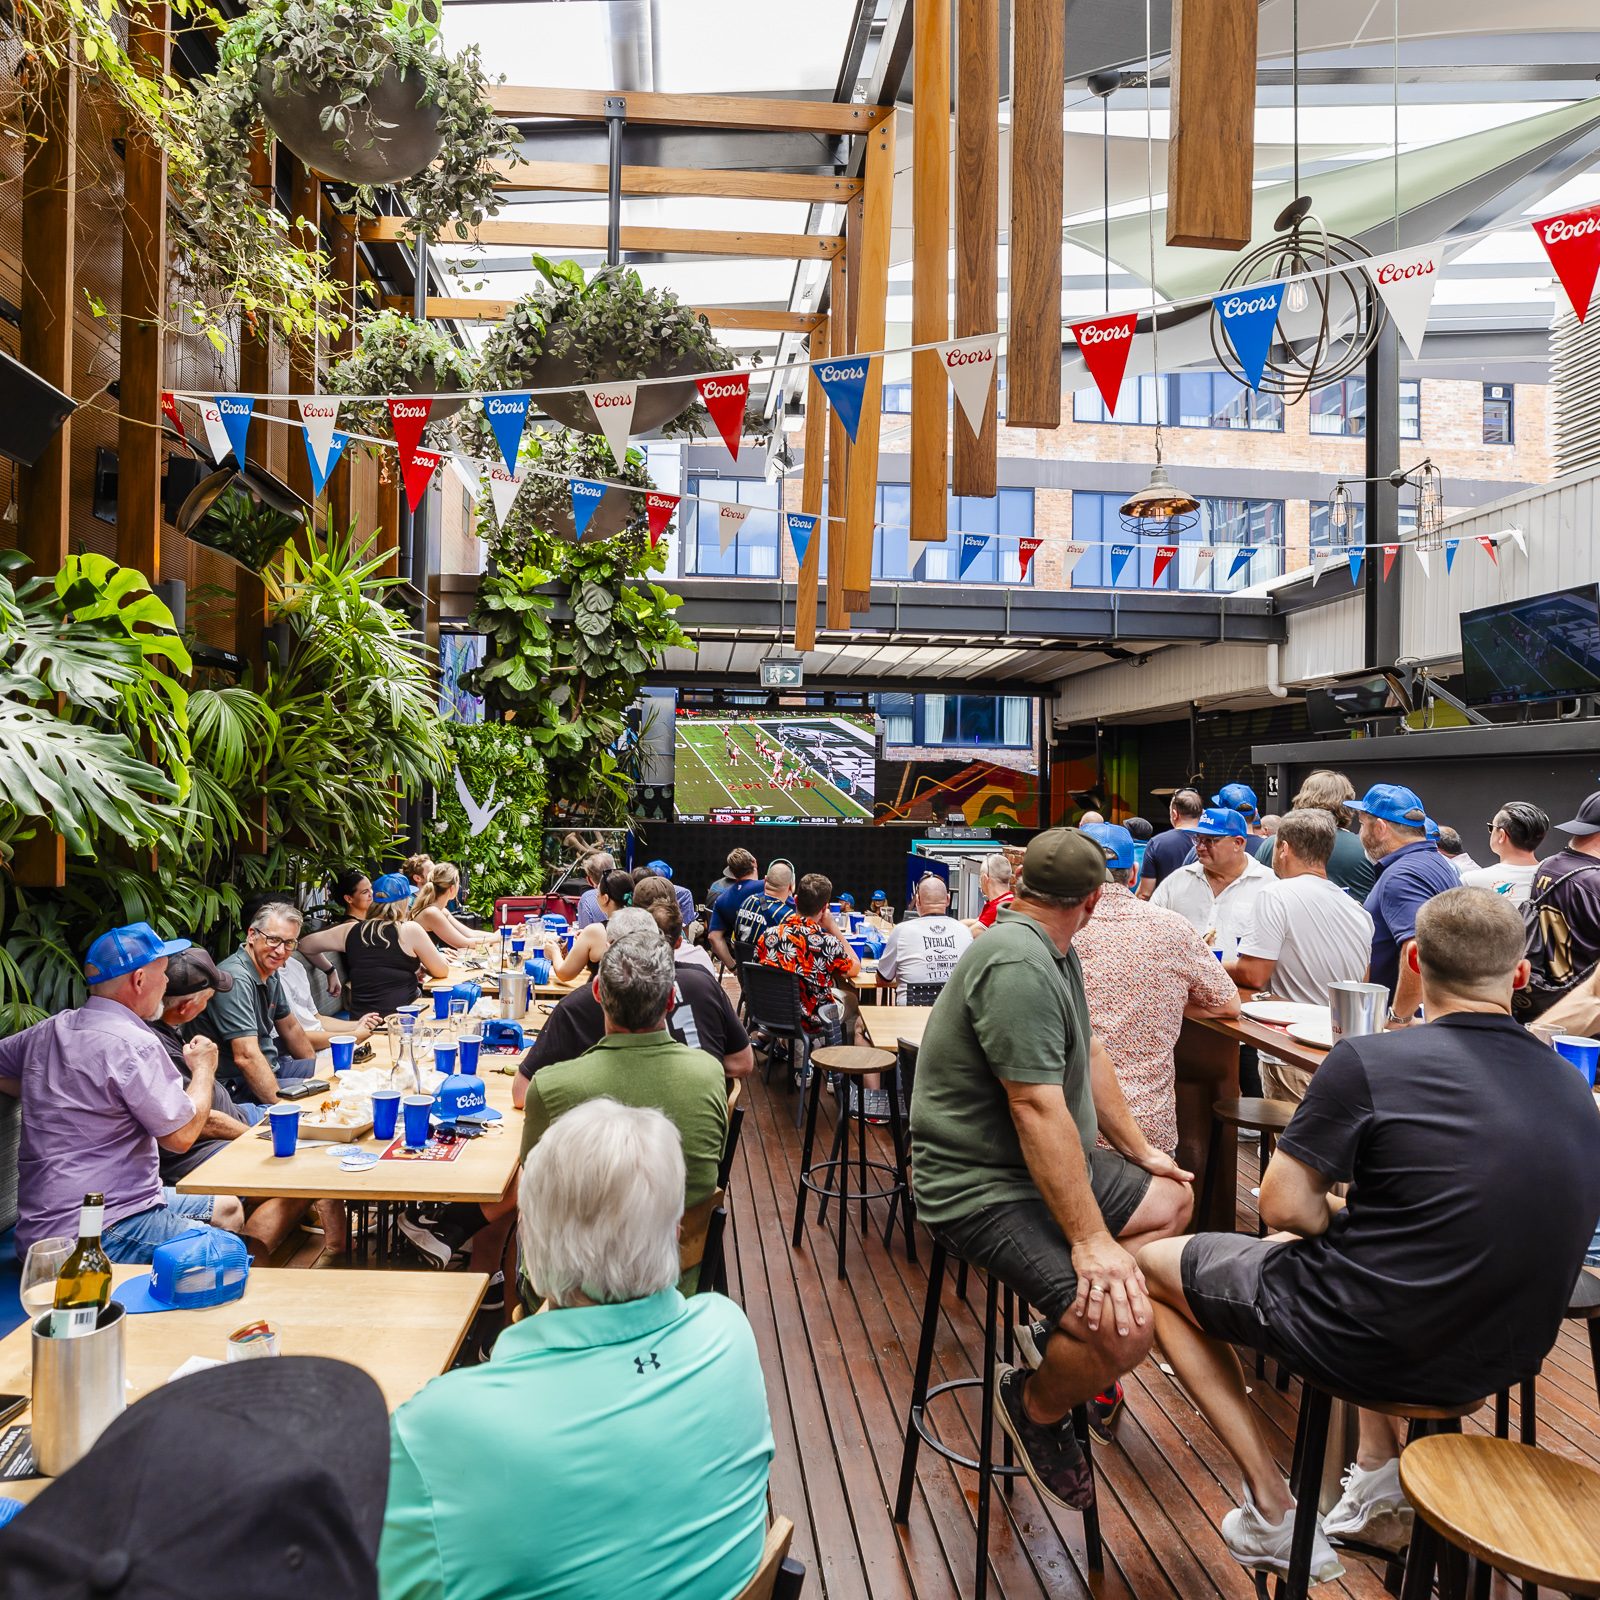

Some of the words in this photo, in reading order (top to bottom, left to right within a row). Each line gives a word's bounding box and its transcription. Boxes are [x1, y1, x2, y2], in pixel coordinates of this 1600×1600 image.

[1377, 256, 1435, 285] Coors
[1223, 292, 1277, 319] Coors
[1079, 323, 1131, 346] Coors
[946, 348, 992, 368] Coors
[820, 365, 864, 383] Coors
[701, 381, 745, 399] Coors
[219, 399, 250, 415] Coors
[488, 398, 525, 414] Coors
[593, 392, 632, 408] Coors
[303, 403, 334, 418] Coors
[392, 402, 427, 418] Coors
[573, 481, 602, 498] Coors
[647, 495, 675, 509] Coors
[720, 506, 745, 520] Coors
[789, 516, 812, 529] Coors
[964, 536, 985, 547] Coors
[1019, 540, 1039, 550] Coors
[1536, 875, 1552, 890] JT
[922, 934, 956, 950] EVERLAST
[926, 970, 953, 978] TITA
[455, 1095, 484, 1109] Coors
